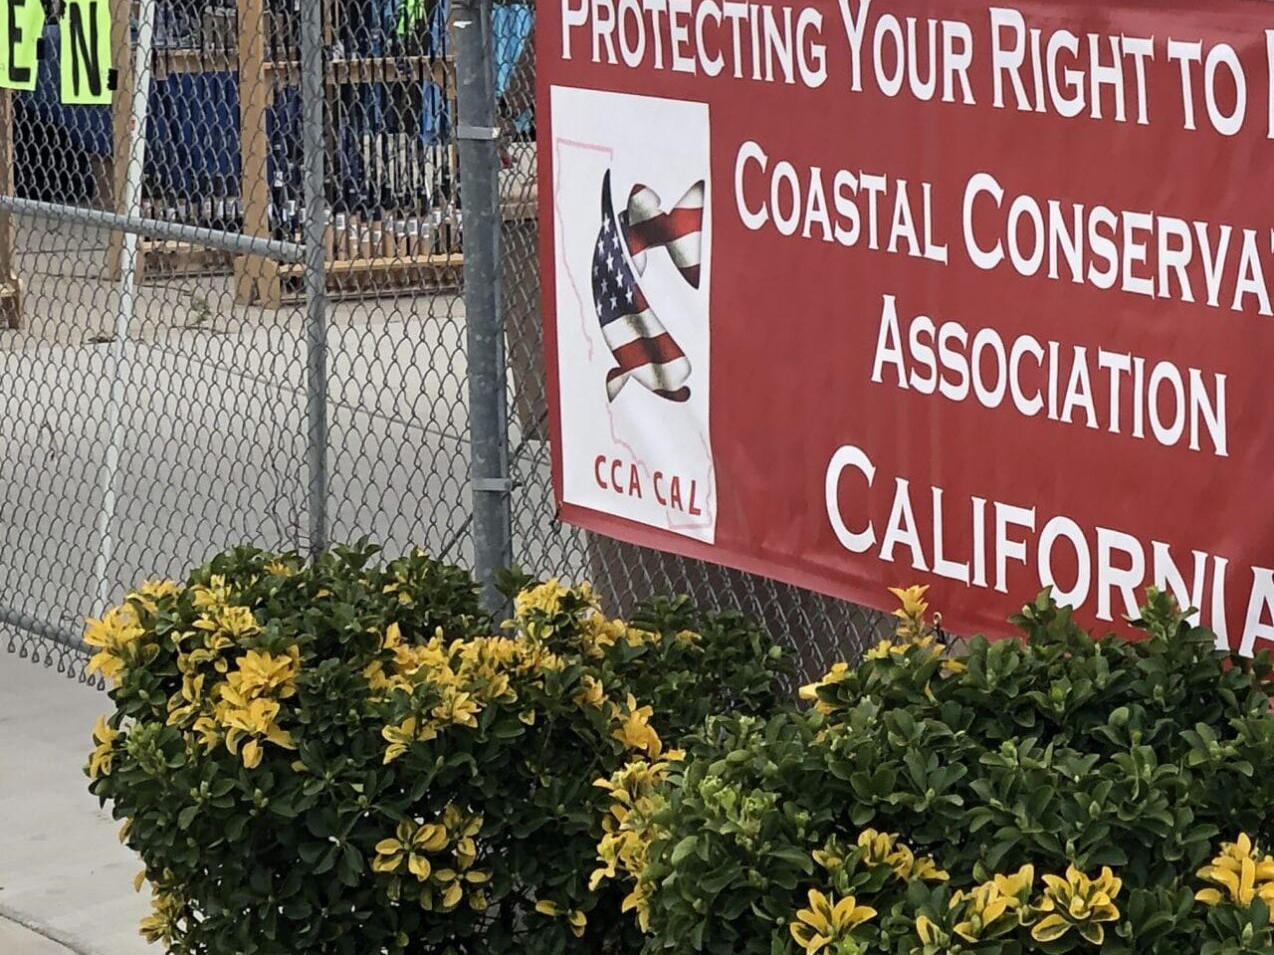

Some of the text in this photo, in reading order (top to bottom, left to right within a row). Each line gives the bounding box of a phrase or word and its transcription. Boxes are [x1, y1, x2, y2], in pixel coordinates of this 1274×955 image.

[989, 7, 1155, 124] RIGHT
[1167, 36, 1247, 136] TO
[735, 140, 947, 266] COASTAL
[871, 294, 1229, 457] ASSOCIATION
[594, 454, 702, 516] CCA CAL
